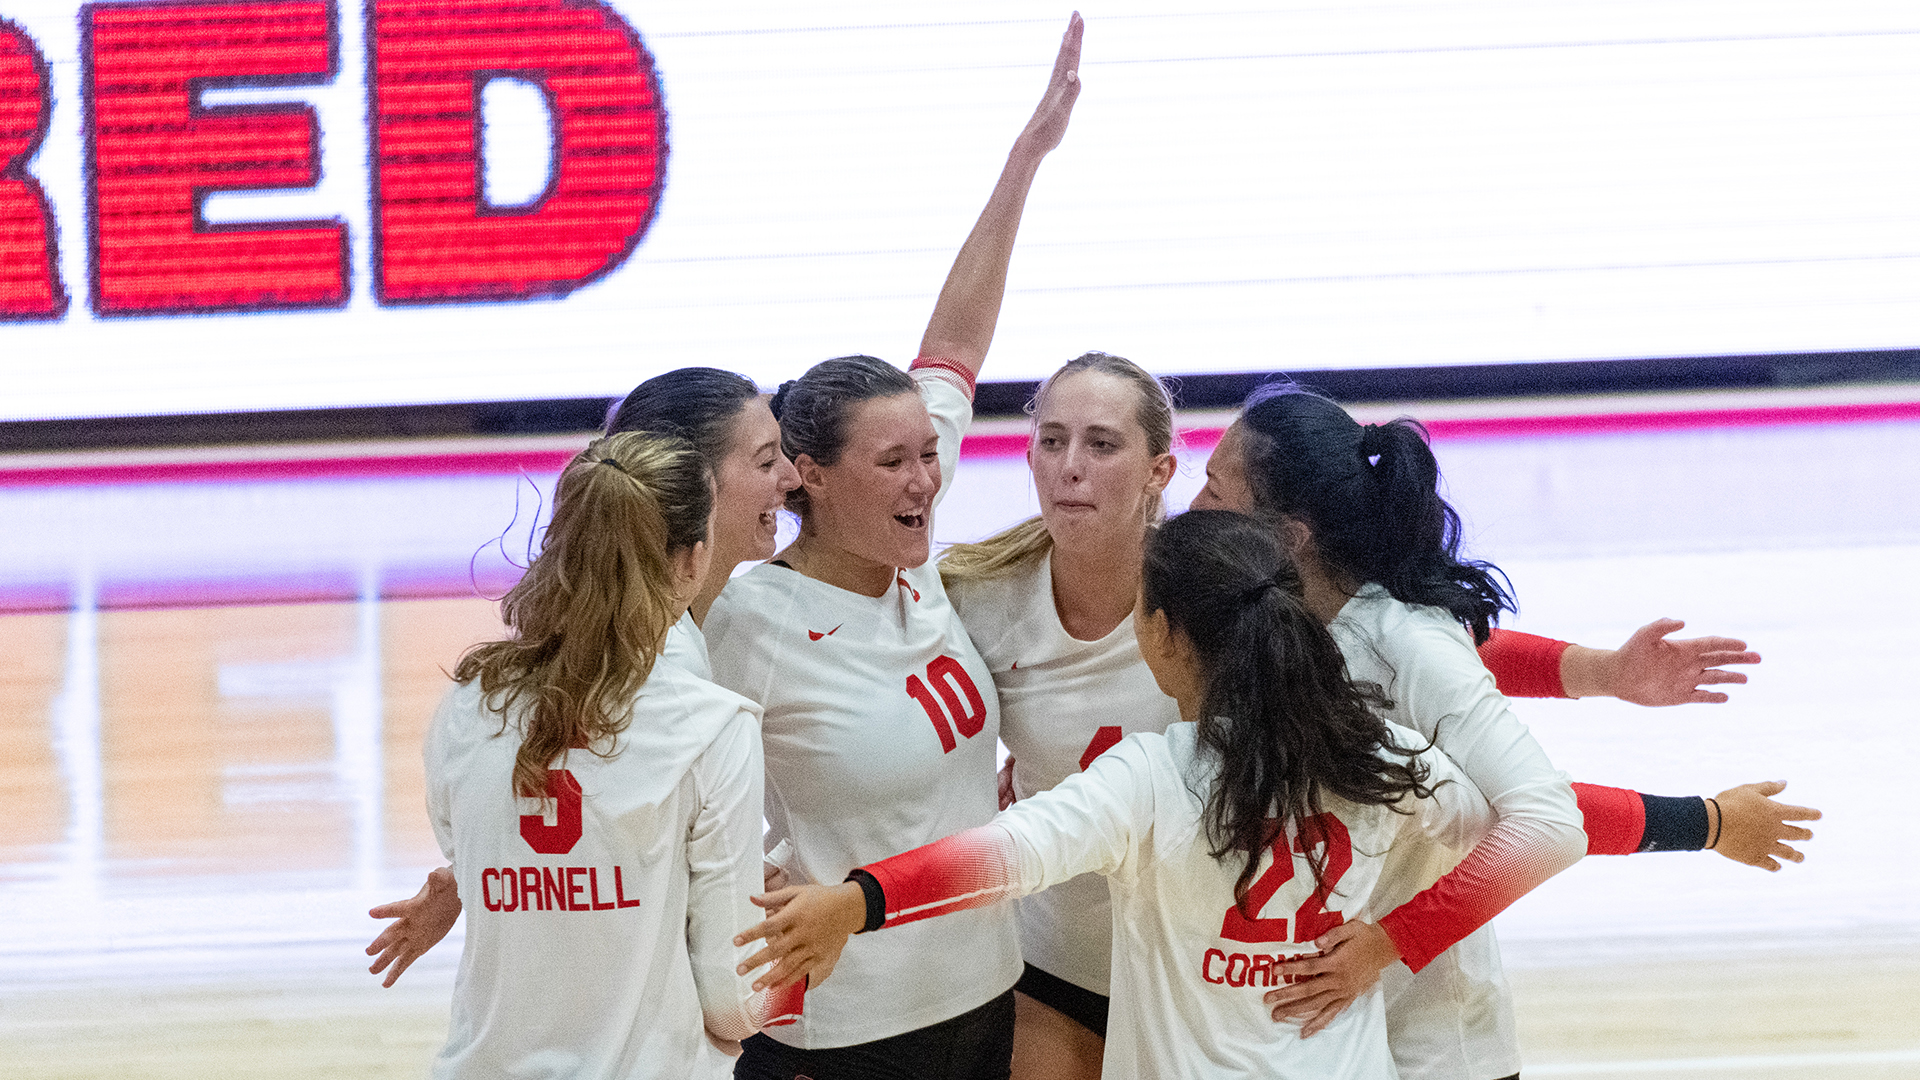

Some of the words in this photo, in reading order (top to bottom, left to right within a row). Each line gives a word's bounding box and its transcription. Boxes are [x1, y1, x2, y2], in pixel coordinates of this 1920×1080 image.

[0, 0, 668, 322] ED
[905, 654, 987, 754] 10
[481, 866, 641, 912] CORNELL
[1220, 812, 1353, 943] 22
